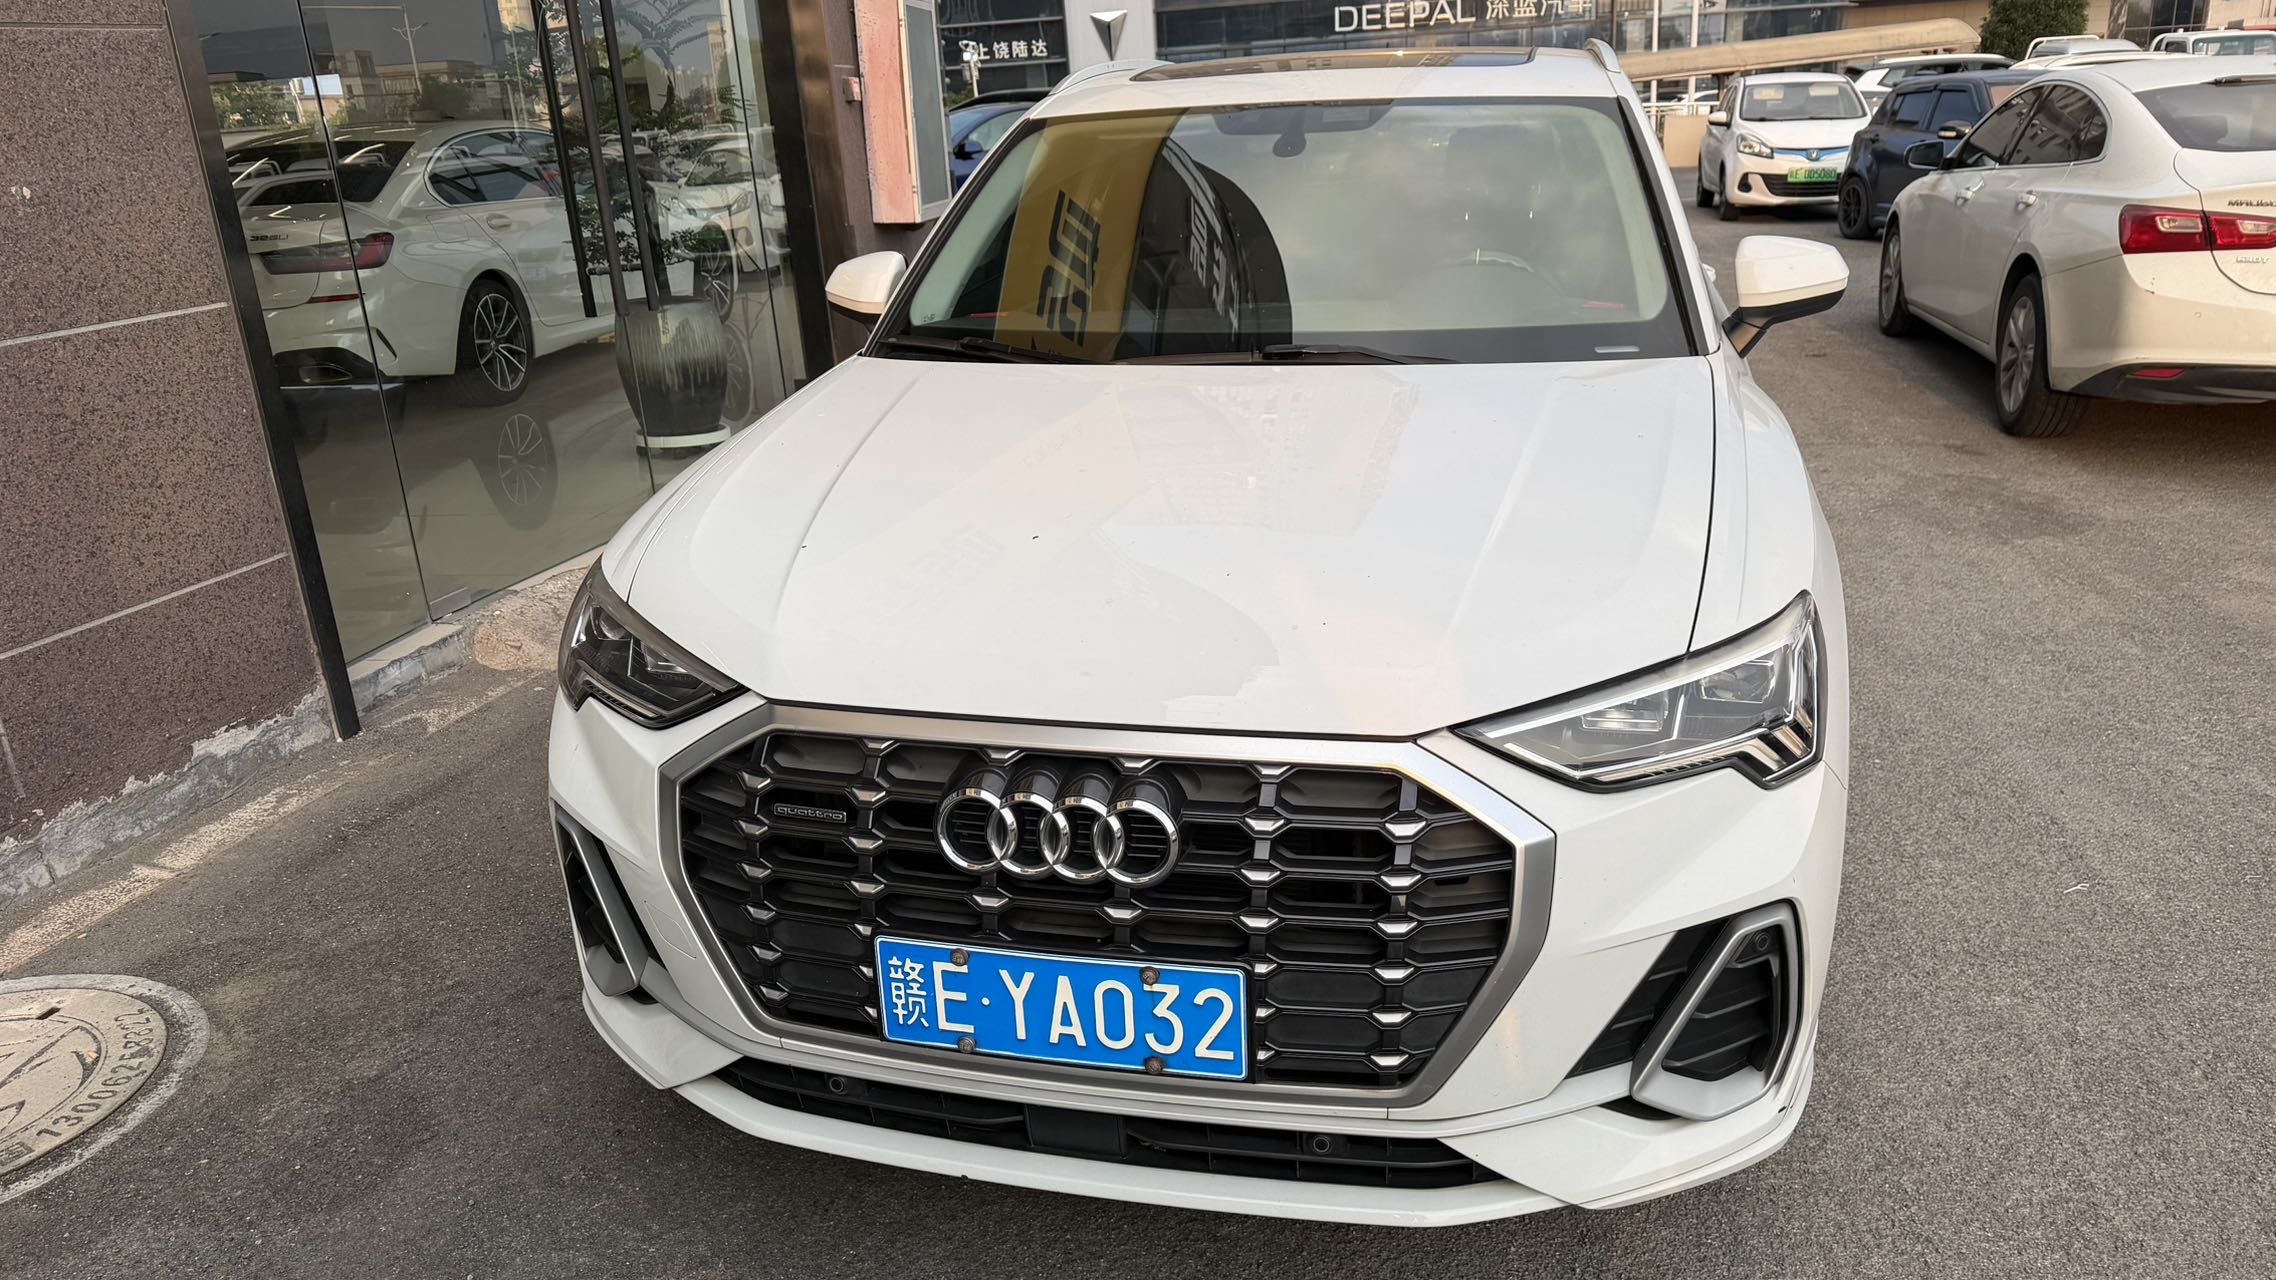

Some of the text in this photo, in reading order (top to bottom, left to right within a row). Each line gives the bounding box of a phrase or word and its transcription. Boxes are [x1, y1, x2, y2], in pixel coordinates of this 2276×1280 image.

[1334, 0, 1475, 32] DEEPAL
[978, 38, 1048, 60] 上饶陆达
[777, 806, 843, 820] quattro
